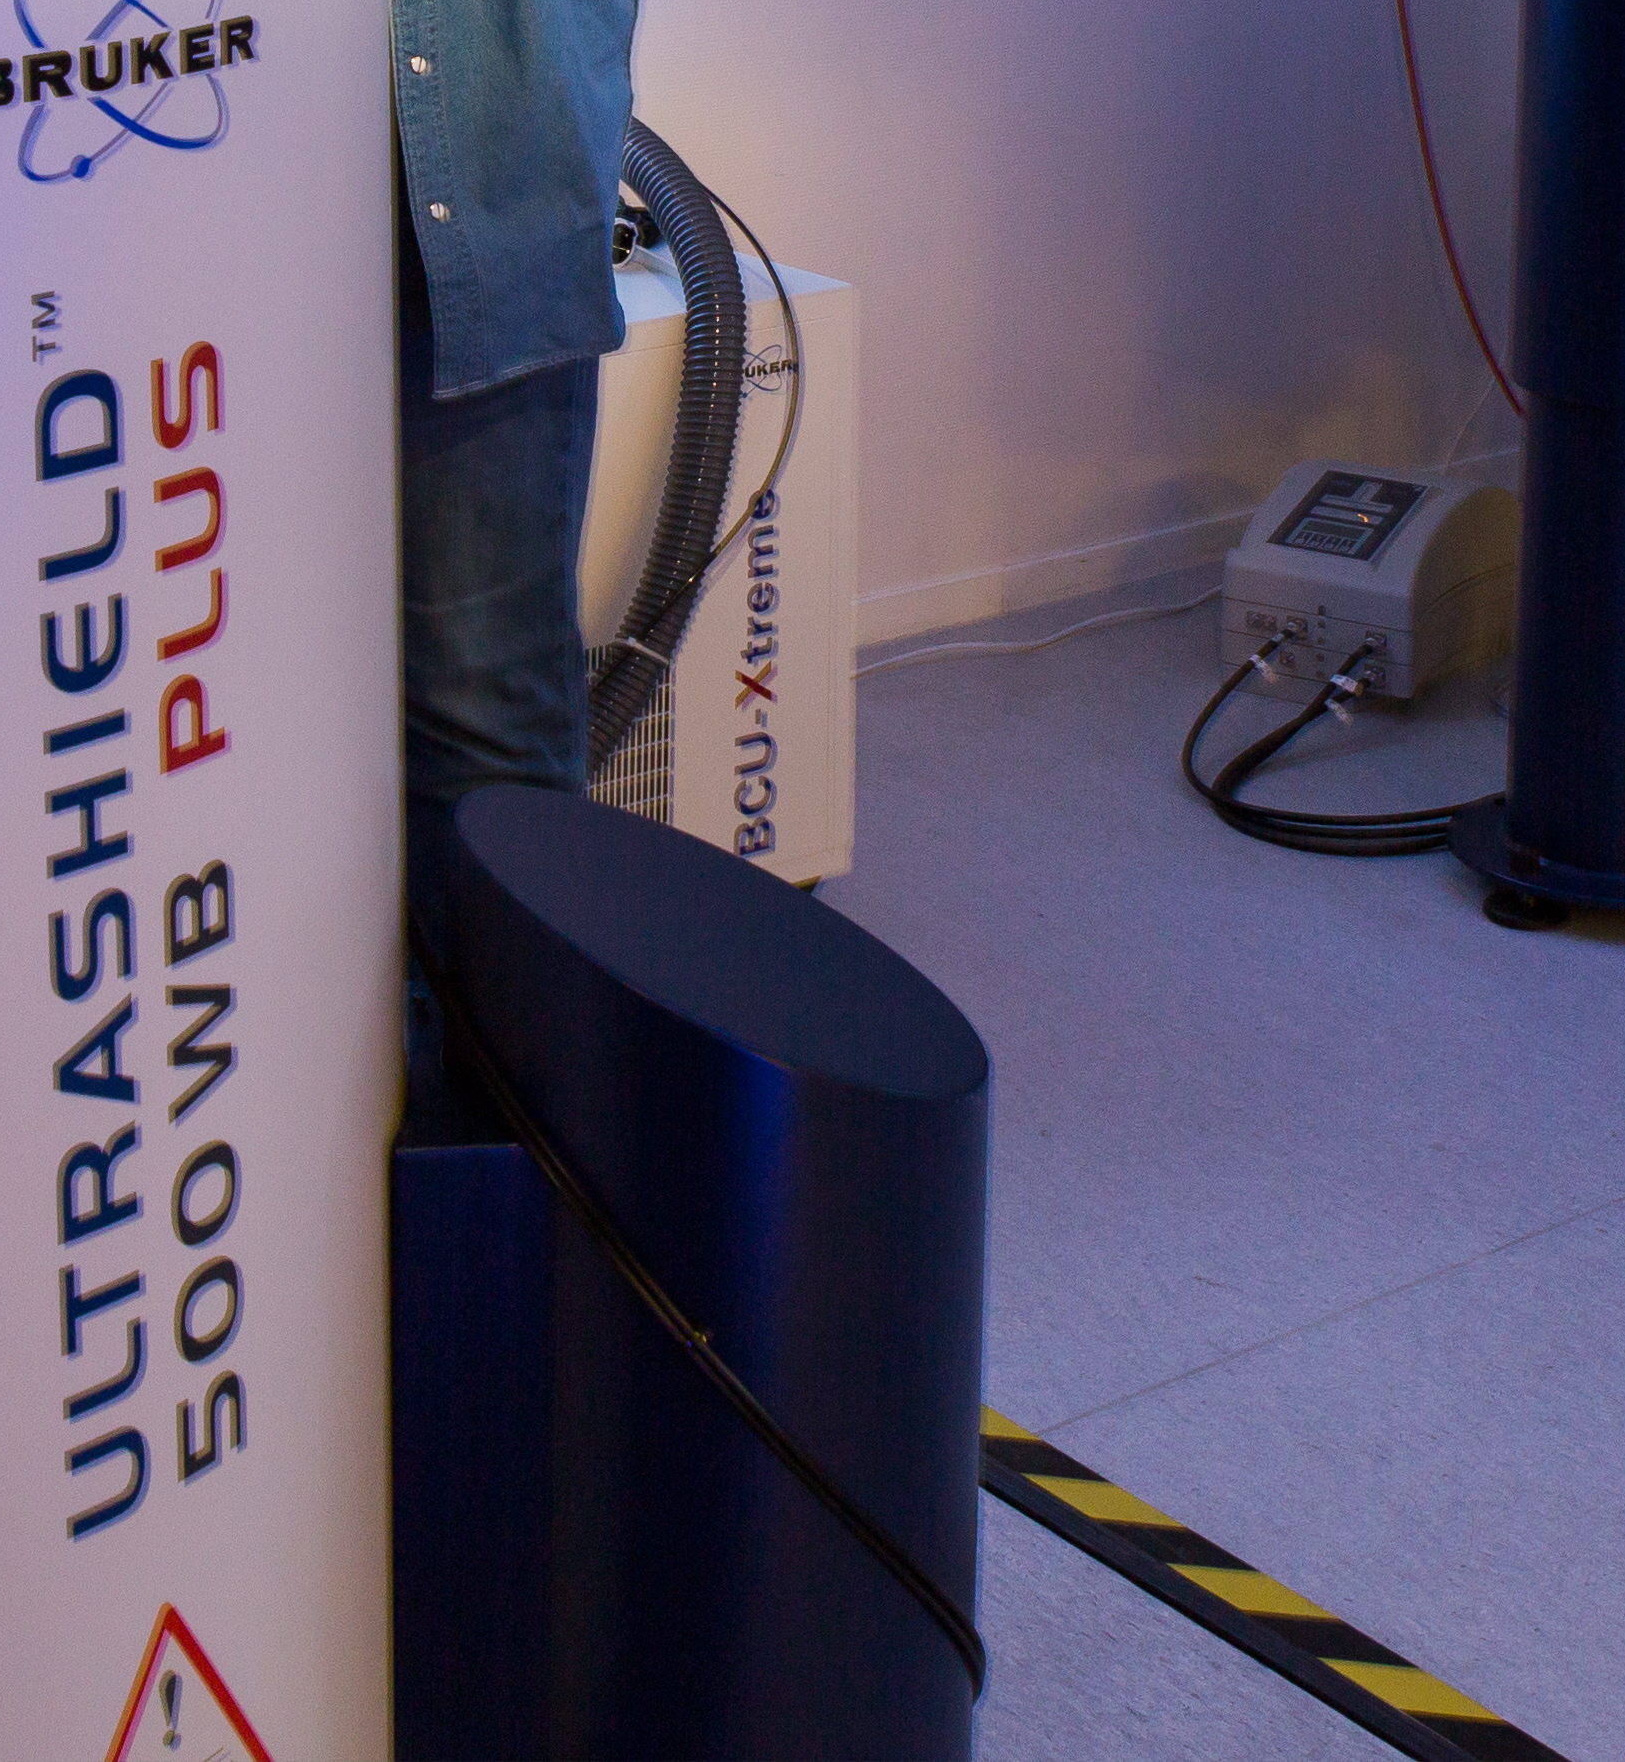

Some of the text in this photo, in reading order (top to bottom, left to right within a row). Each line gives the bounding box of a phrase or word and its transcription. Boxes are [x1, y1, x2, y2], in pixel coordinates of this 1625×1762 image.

[35, 368, 151, 1542] ULTRASHIELD
[150, 340, 250, 1487] 500WB PLUS
[733, 488, 780, 858] BCU-Xtreme
